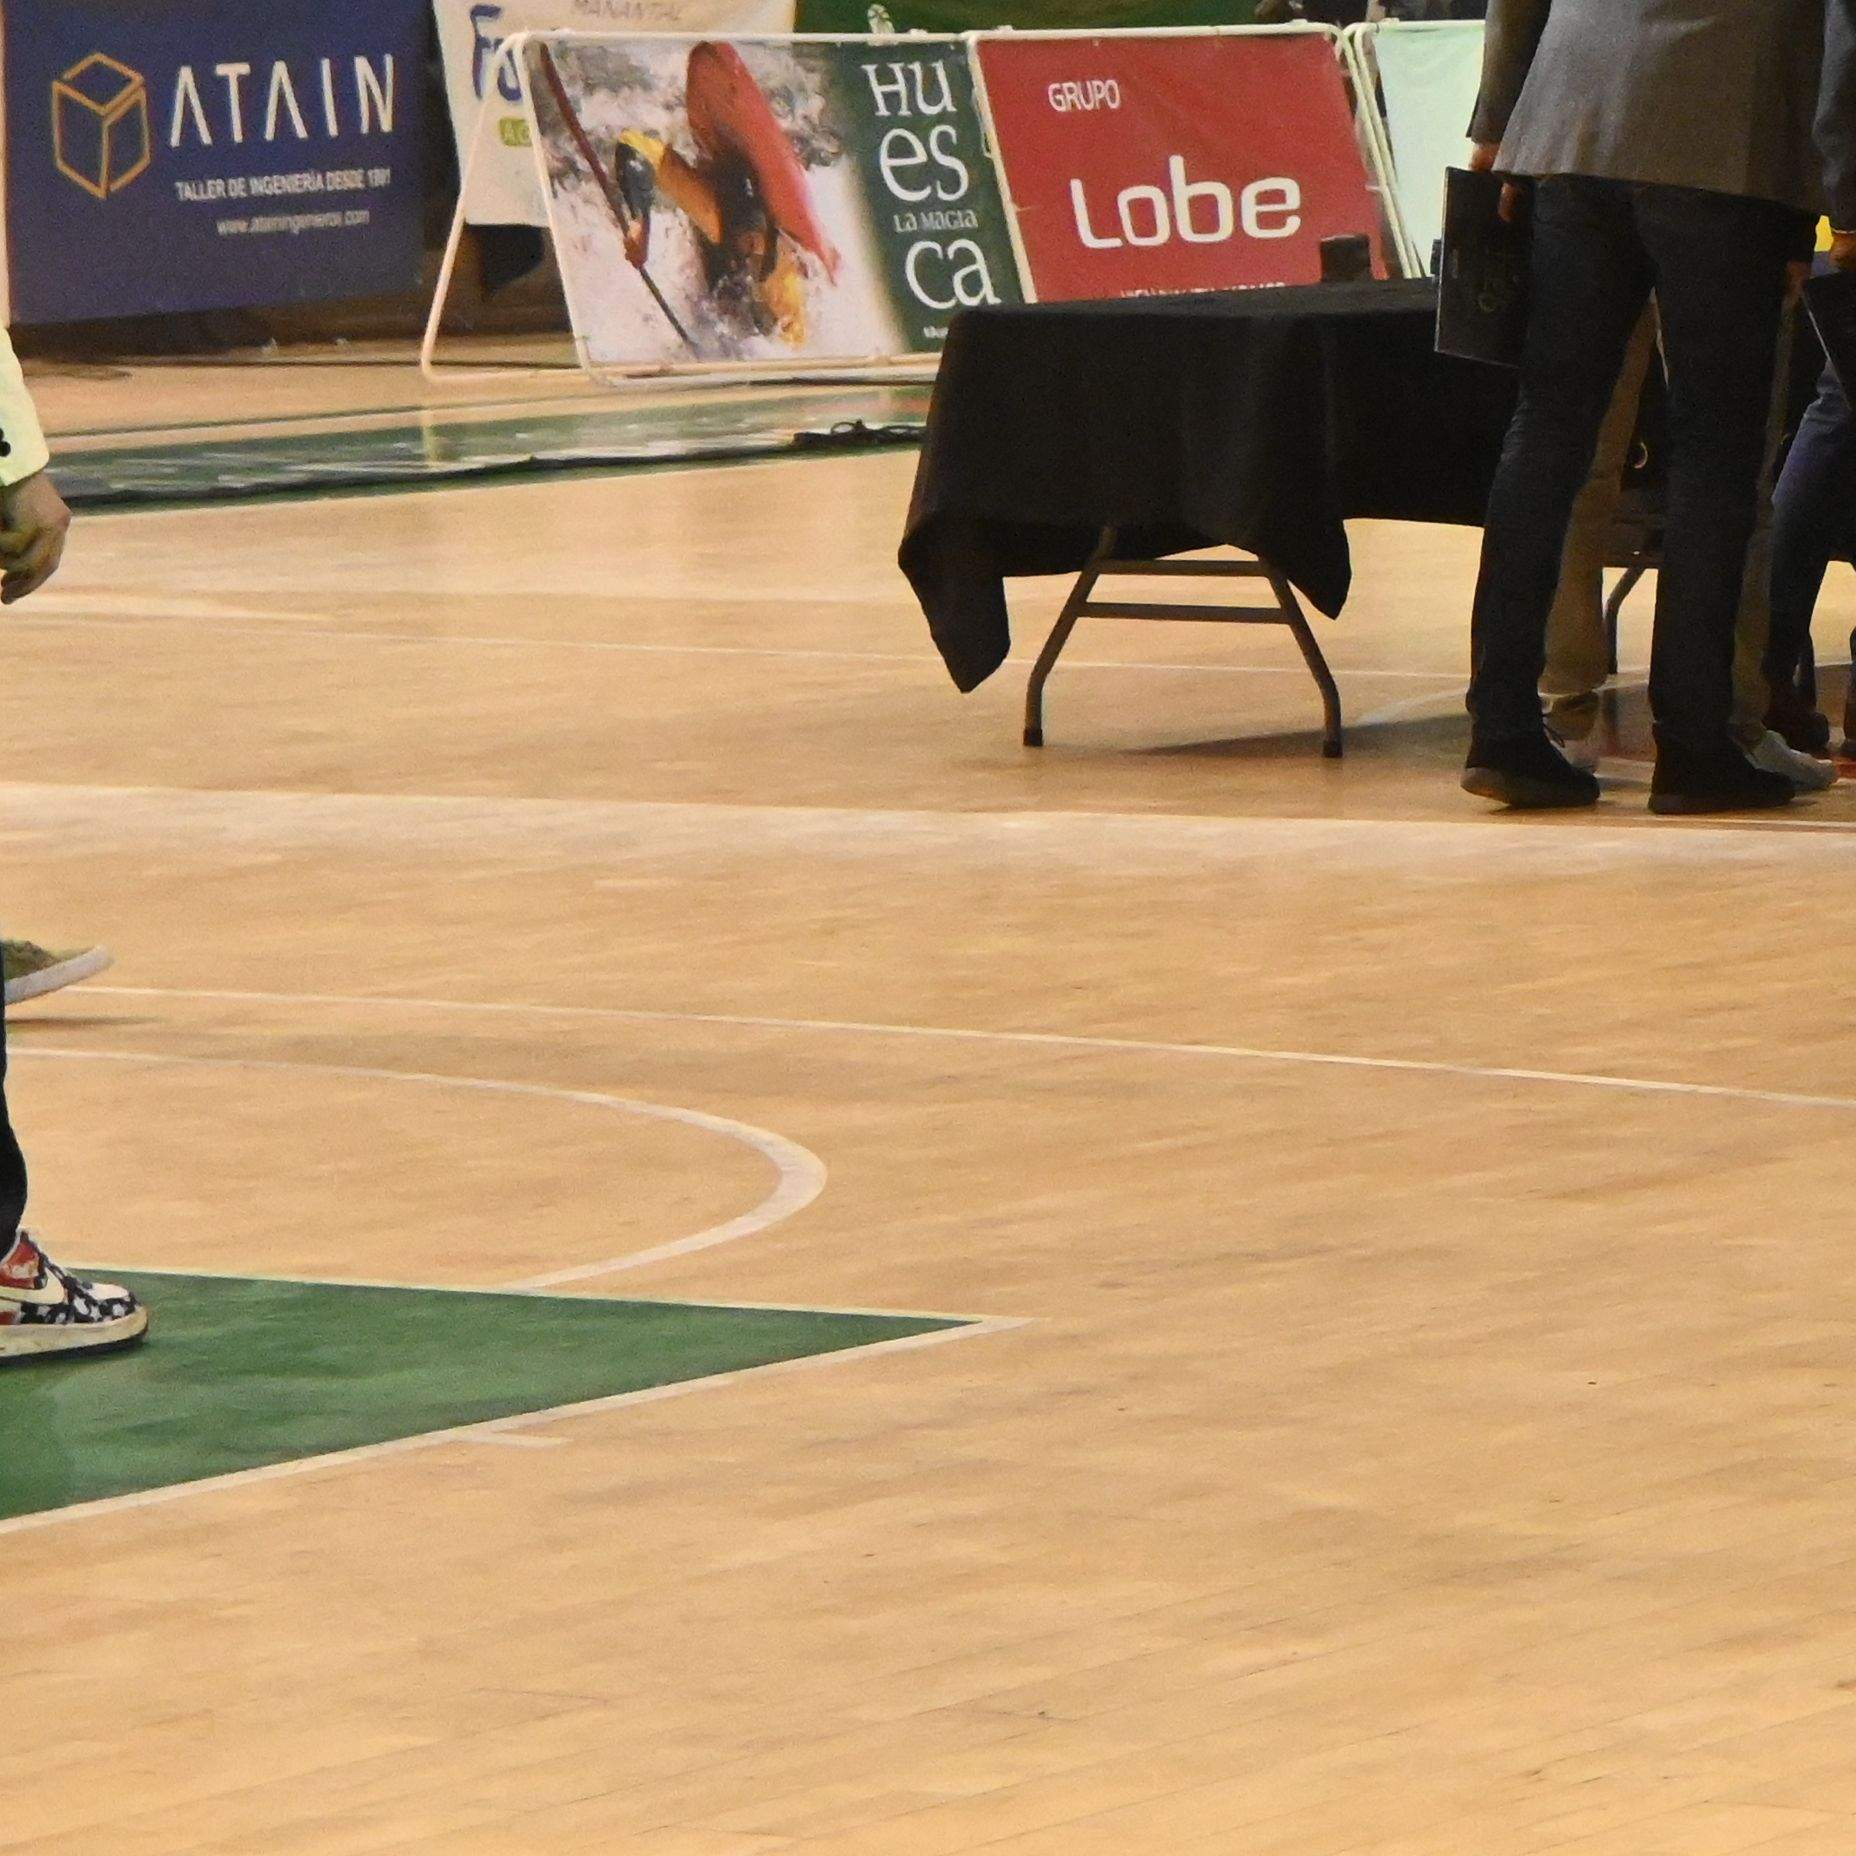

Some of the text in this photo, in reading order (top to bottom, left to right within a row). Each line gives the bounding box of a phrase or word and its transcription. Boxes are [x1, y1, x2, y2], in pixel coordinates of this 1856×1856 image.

[170, 52, 395, 148] ATAIN
[1047, 77, 1121, 113] GRUPO
[174, 177, 228, 202] TALLER
[227, 176, 248, 199] DE
[1068, 153, 1302, 250] Lobe
